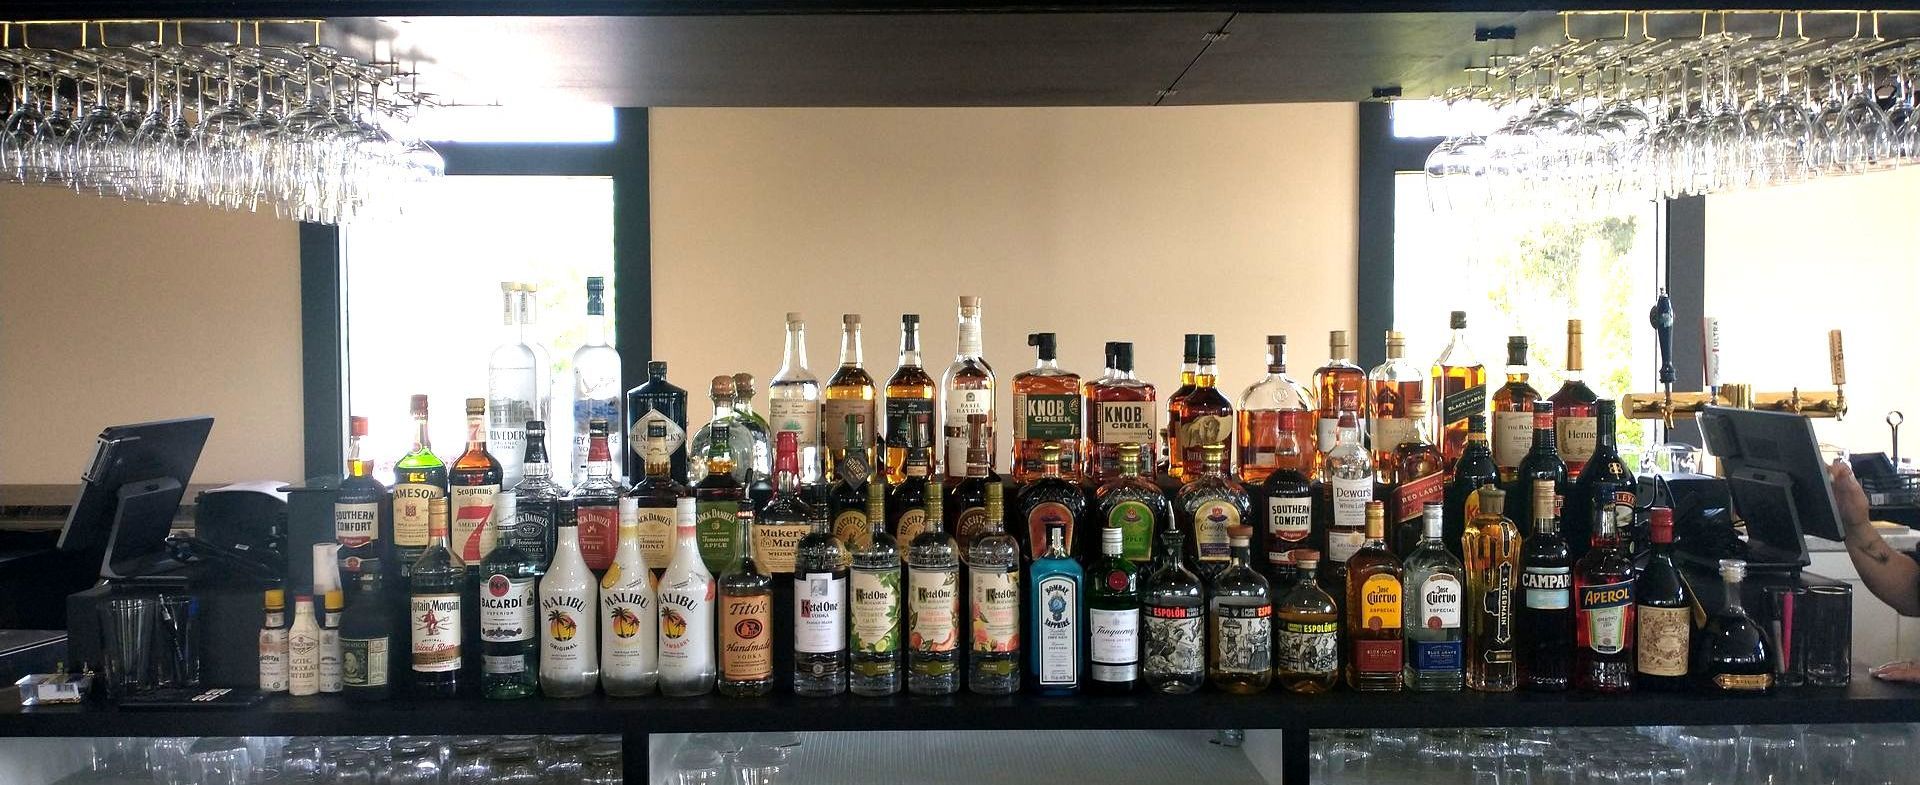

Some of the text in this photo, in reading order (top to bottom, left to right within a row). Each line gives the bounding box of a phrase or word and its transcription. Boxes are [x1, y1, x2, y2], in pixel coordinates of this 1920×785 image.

[1028, 399, 1065, 417] KNOB
[1447, 400, 1466, 411] BLACK
[1466, 395, 1485, 405] LABEL
[1105, 406, 1142, 422] KNOB
[1568, 429, 1596, 439] Henne
[456, 486, 493, 497] Seagram's
[1336, 487, 1372, 498] Dewar's
[1401, 484, 1443, 503] RED LABEL
[336, 510, 374, 521] SOUTHERN
[1272, 504, 1309, 515] SOUTHERN
[337, 521, 372, 531] COMFORT
[1274, 515, 1309, 525] COMFORT
[456, 504, 494, 561] 7
[760, 529, 806, 538] Maker's
[856, 588, 888, 603] Ketel One
[917, 587, 951, 604] Ketel One
[986, 587, 1006, 603] Ketel
[1044, 584, 1069, 596] BOMBAY
[1377, 585, 1389, 594] Jose
[1436, 585, 1449, 594] Jose
[482, 595, 522, 609] BACARDÍ
[542, 595, 587, 613] MALIBU
[605, 592, 650, 609] MALIBU
[1367, 590, 1397, 605] Cuervo
[1426, 590, 1456, 605] Cuervo
[1585, 588, 1630, 606] APEROL
[431, 599, 459, 613] Morgan
[729, 600, 767, 616] Tito's
[801, 599, 838, 615] Ketel One
[1044, 617, 1071, 630] SAPPHIRE
[1096, 625, 1135, 638] Tanqueray
[550, 642, 578, 652] ORIGINAL
